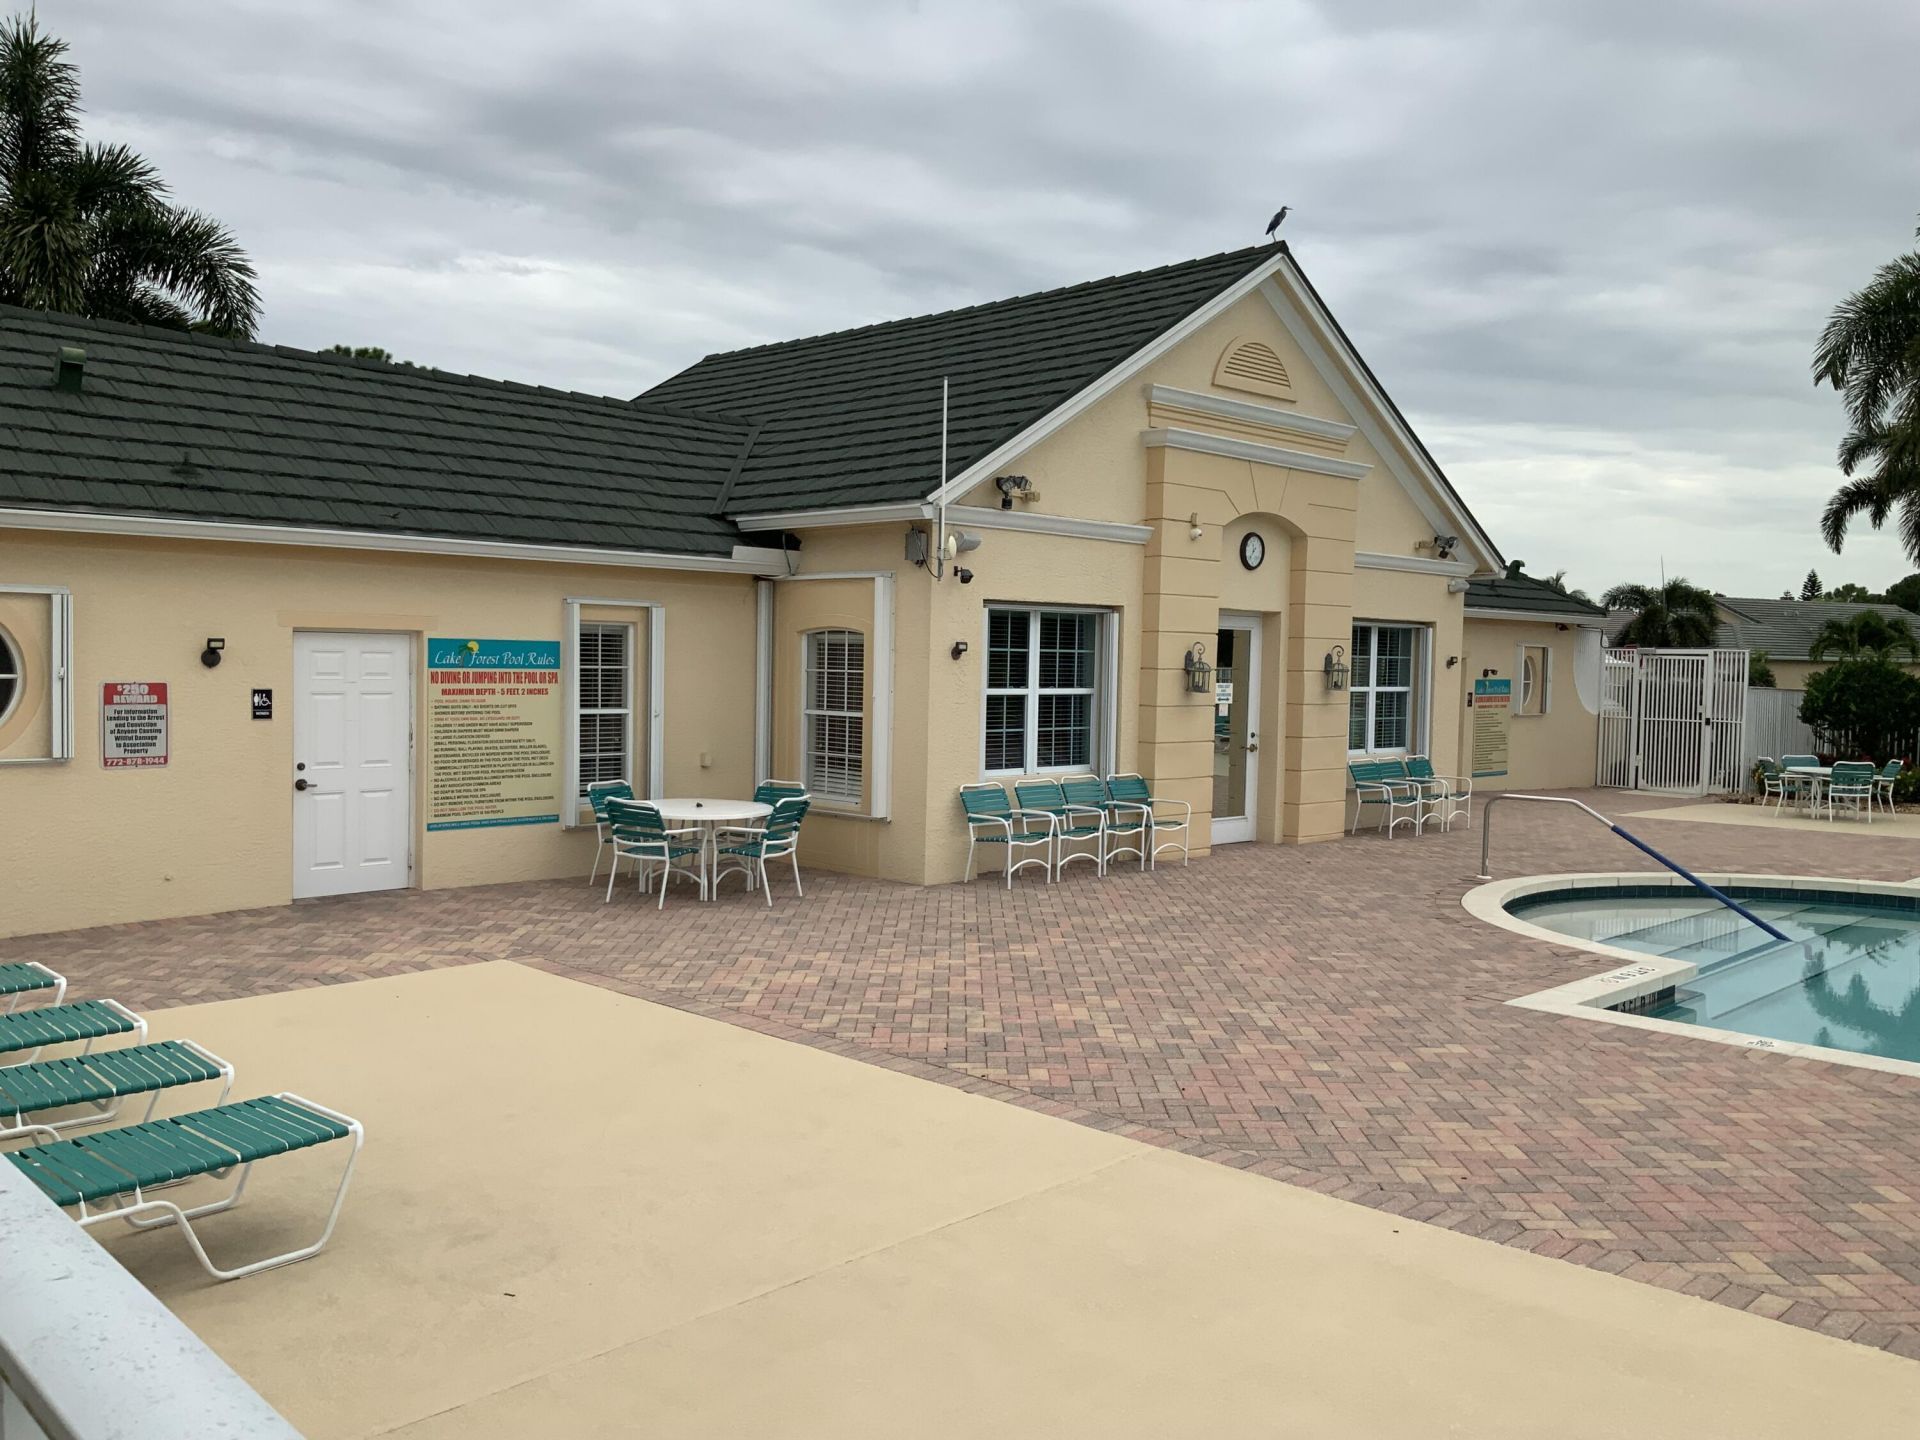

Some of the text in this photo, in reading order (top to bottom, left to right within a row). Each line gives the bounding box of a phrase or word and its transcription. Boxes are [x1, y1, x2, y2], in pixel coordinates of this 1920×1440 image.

[435, 651, 555, 667] Lake Forest Pool Rules
[431, 671, 558, 684] NO DIVING OR JUMPING INTO THE POOL OR SPA
[113, 695, 158, 703] REWARD
